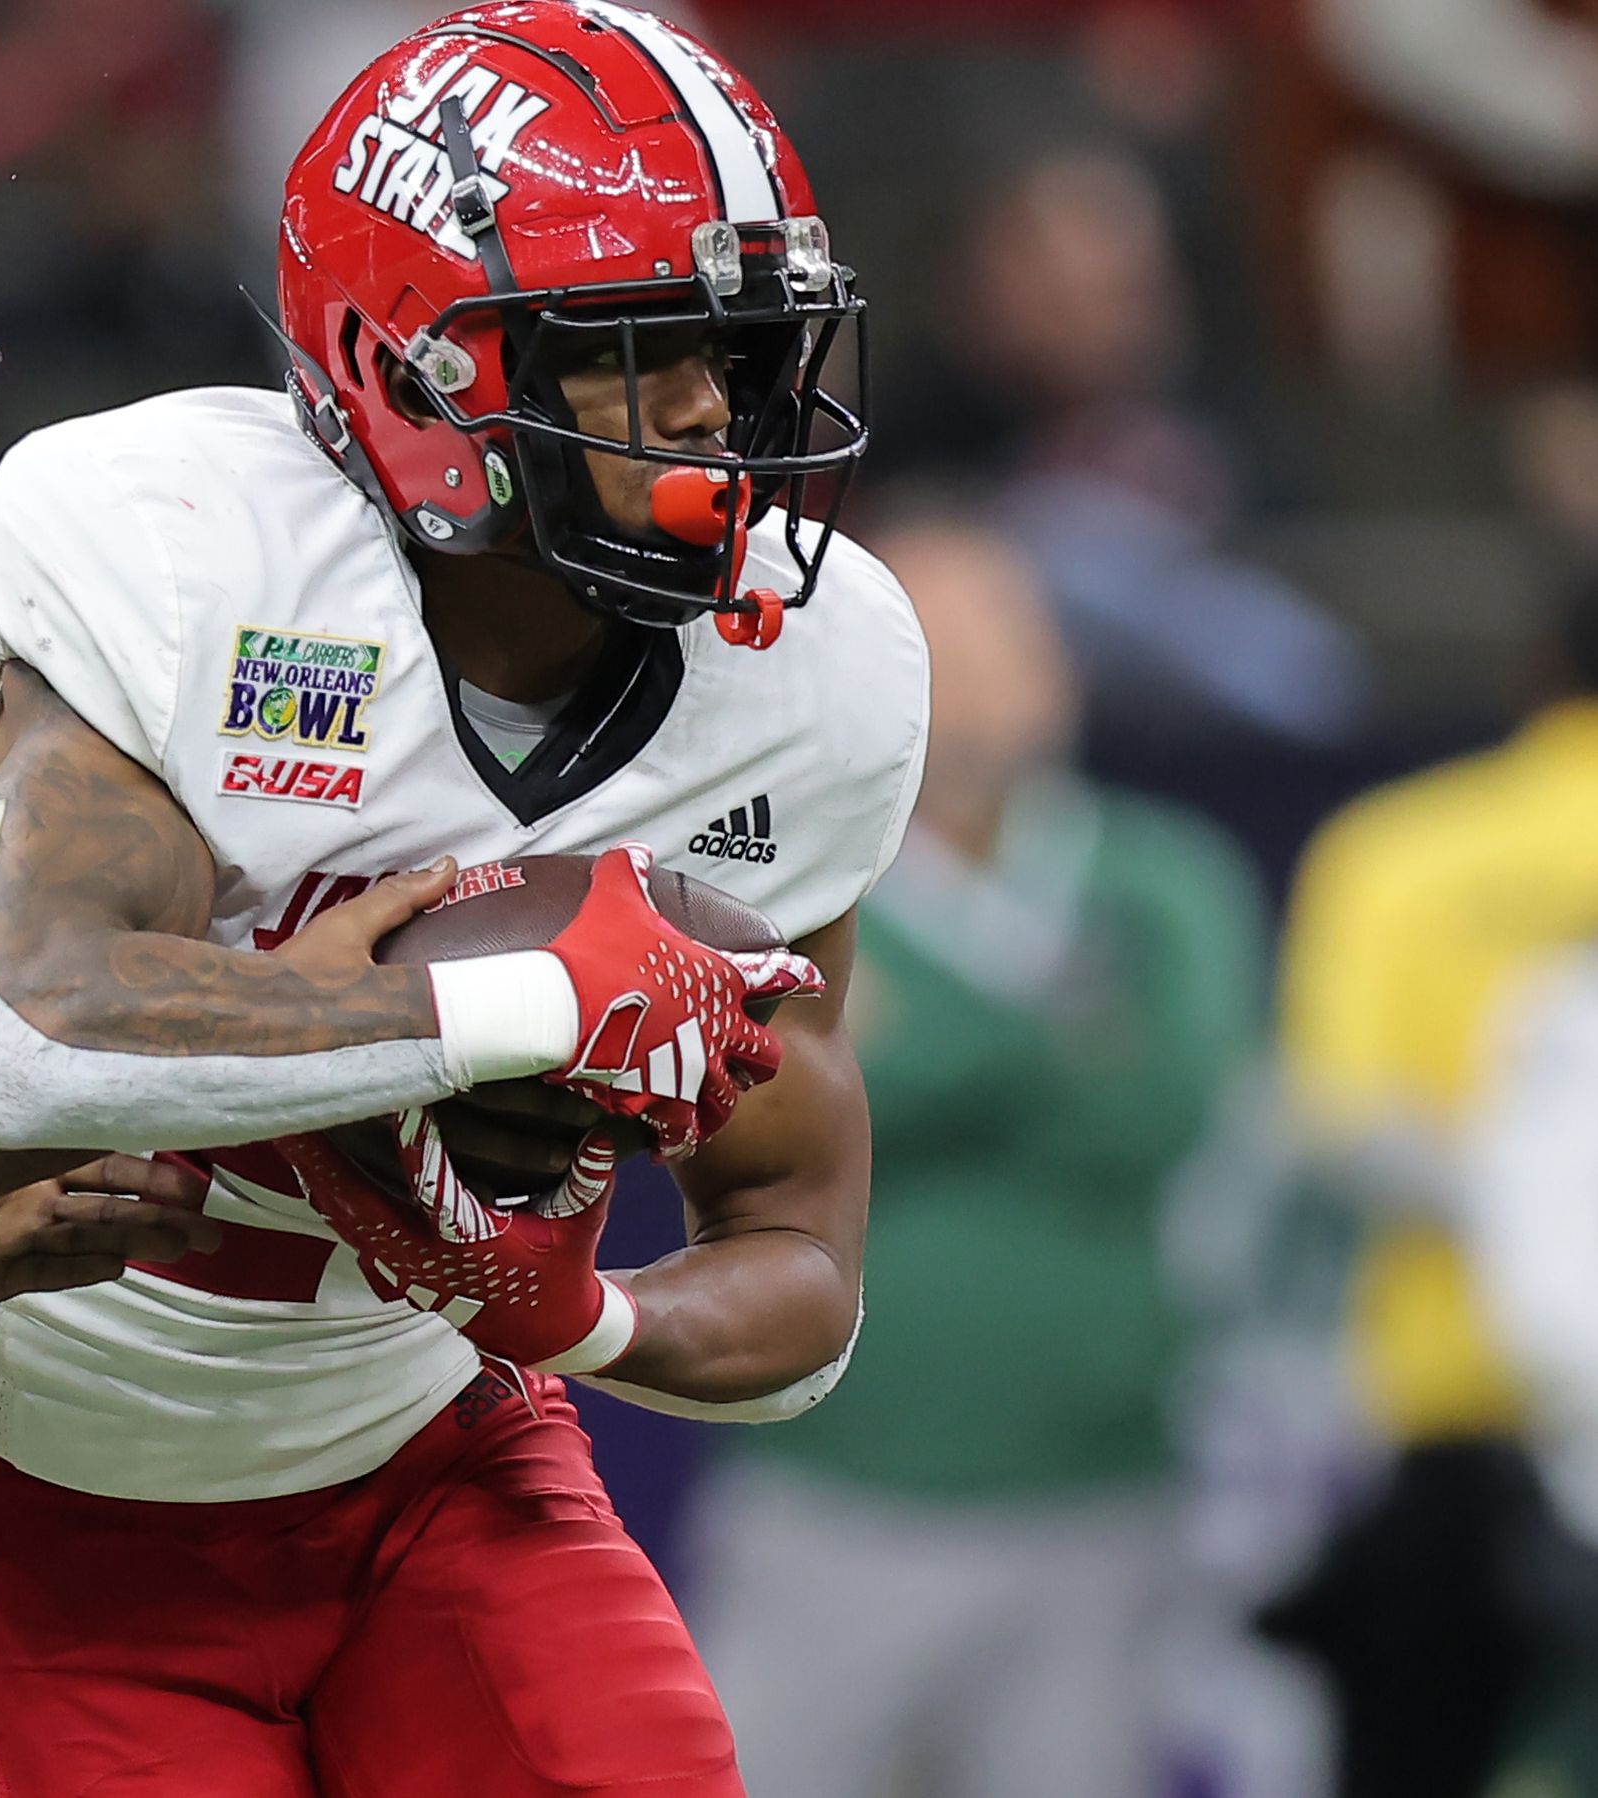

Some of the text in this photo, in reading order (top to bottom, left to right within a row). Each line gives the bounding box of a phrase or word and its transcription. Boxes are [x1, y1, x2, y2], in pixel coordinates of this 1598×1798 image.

[385, 54, 551, 174] JAX
[334, 114, 511, 261] STATE
[234, 659, 376, 696] NEW ORLEANS
[225, 683, 365, 745] BOWL
[455, 861, 503, 883] AX
[688, 832, 777, 865] adidas
